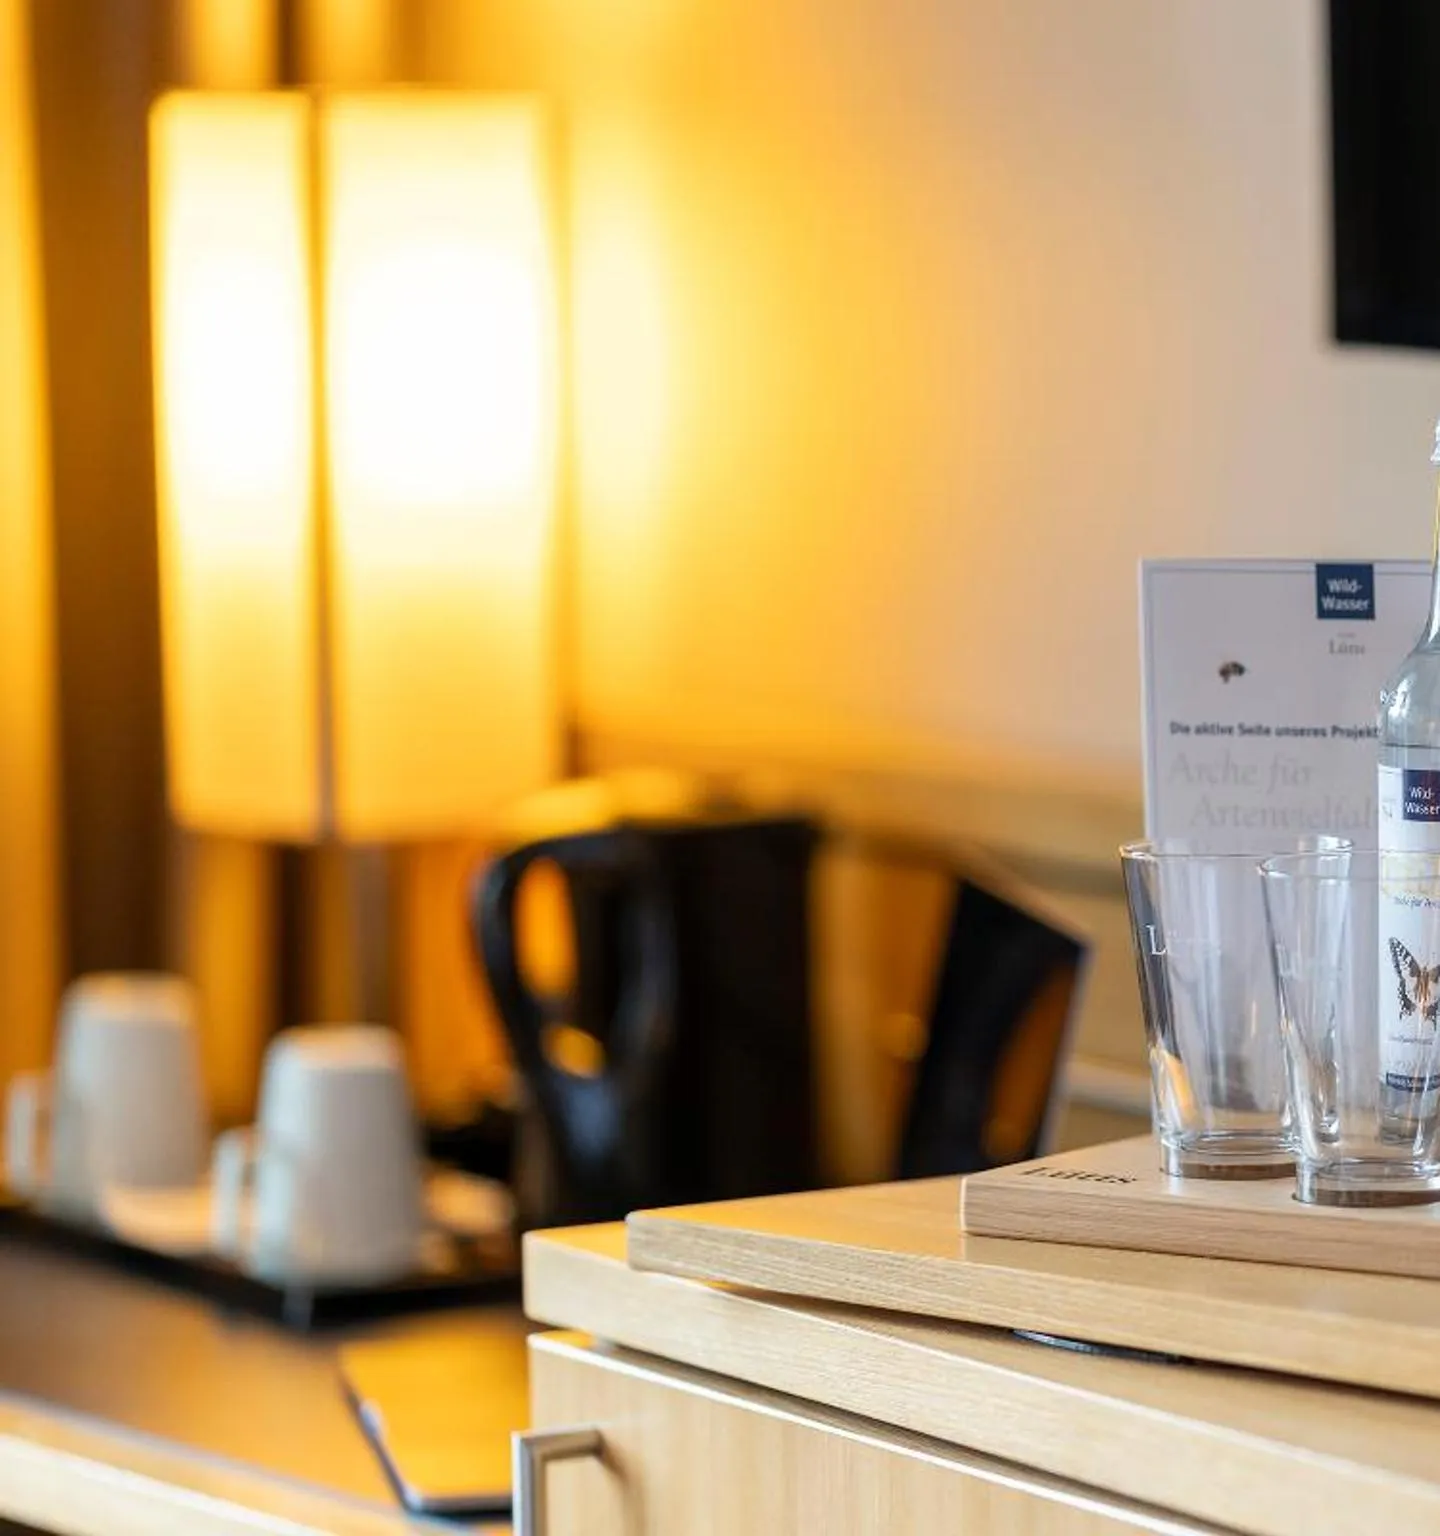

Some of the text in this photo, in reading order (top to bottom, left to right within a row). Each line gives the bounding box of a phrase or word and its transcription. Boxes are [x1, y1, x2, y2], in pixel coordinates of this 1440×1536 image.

[1327, 578, 1363, 593] Wild-
[1321, 596, 1371, 611] Wasser
[1170, 721, 1190, 735] Die
[1195, 722, 1234, 737] aktive
[1238, 723, 1271, 737] Seite
[1275, 726, 1327, 738] unseres
[1168, 750, 1313, 795] Arche für
[1405, 801, 1440, 815] Wasser
